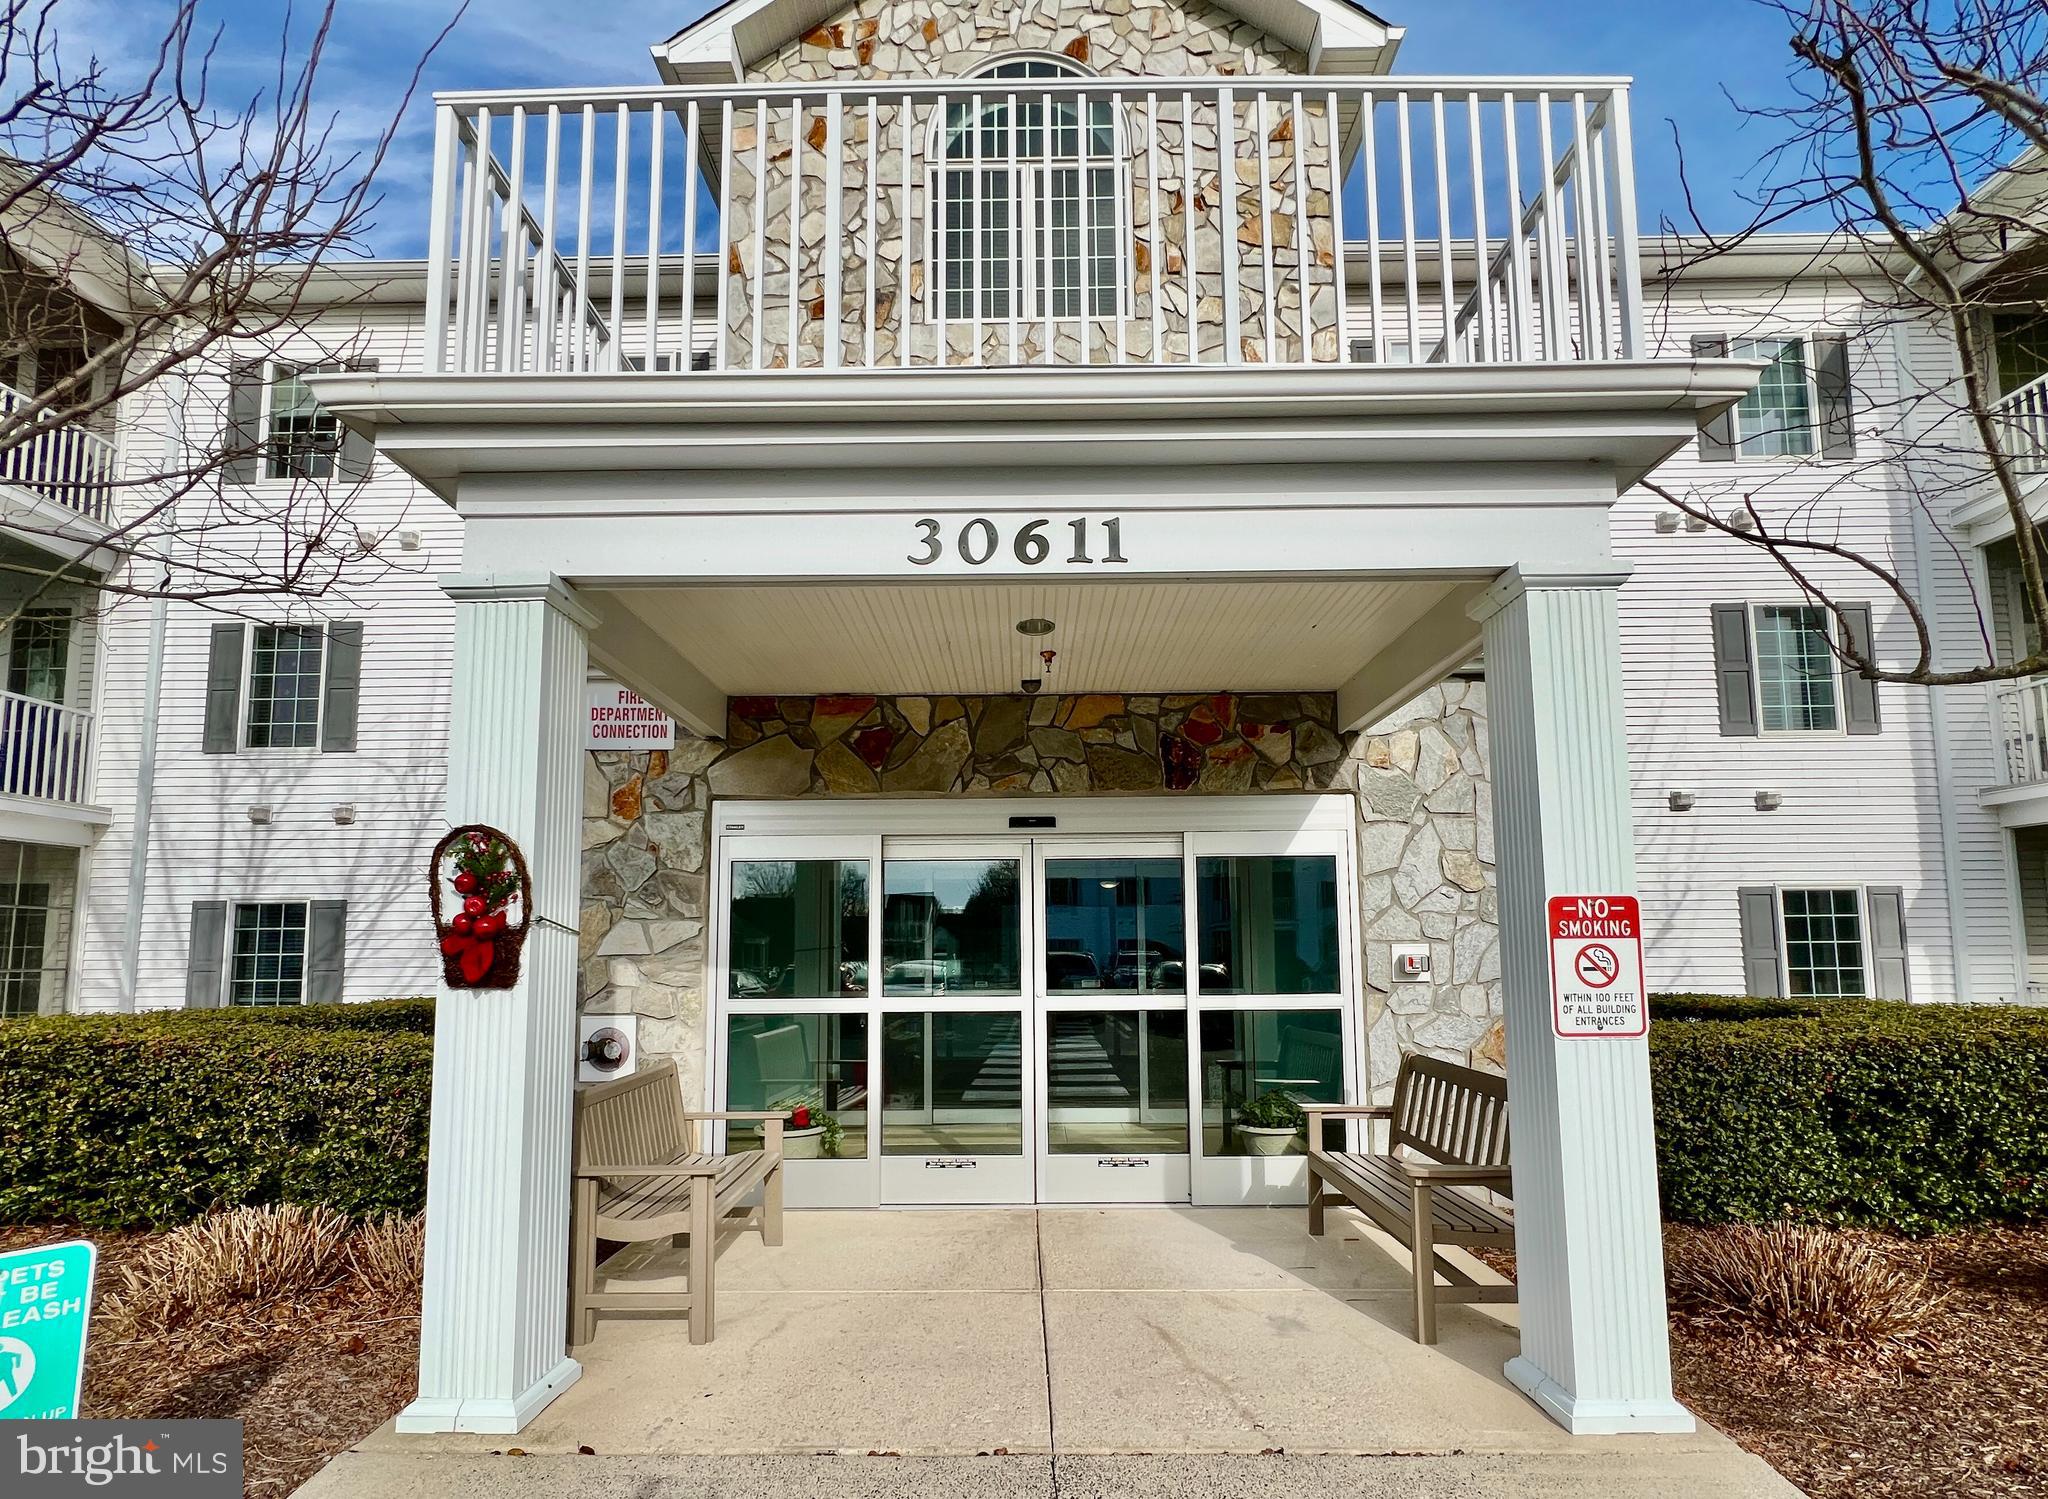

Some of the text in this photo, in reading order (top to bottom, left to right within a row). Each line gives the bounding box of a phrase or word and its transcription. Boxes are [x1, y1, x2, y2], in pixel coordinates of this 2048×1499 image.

[907, 516, 1129, 565] 30611
[592, 724, 668, 738] CONNECTION
[1558, 920, 1631, 937] SMOKING
[1563, 992, 1634, 1003] WITHIN 100 FEET
[1563, 1004, 1637, 1014] OF ALL BUILDING
[1575, 1016, 1625, 1026] ENTRANCES
[20, 1280, 59, 1305] BE
[0, 1297, 81, 1329] EASH
